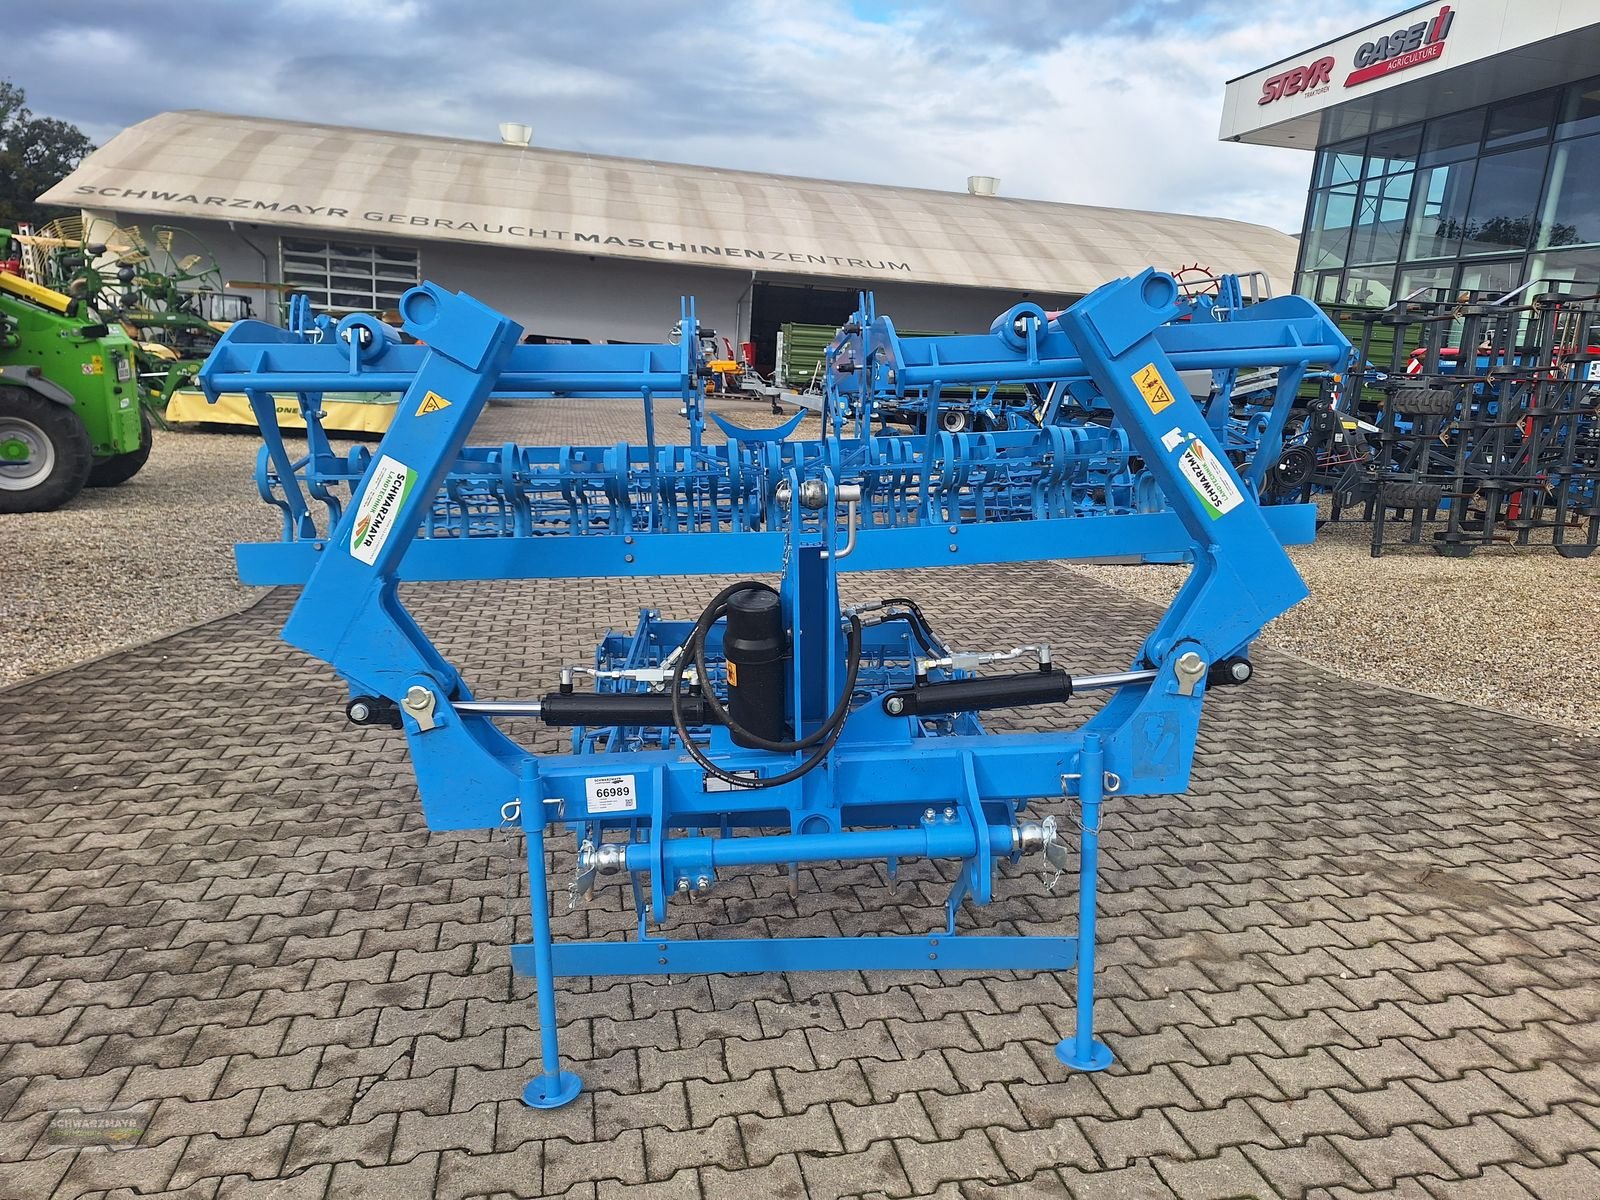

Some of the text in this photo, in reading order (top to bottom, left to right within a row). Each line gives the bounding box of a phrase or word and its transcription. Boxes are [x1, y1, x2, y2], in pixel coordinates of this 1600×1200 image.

[1353, 21, 1428, 68] CASE
[1387, 45, 1437, 70] AGRICULTURE
[1258, 56, 1335, 105] STEYR
[1304, 85, 1331, 98] TRAKTOREN
[74, 185, 912, 272] SCHWARZMAYR GEBRAUCHTMASCHINENZENTRUM
[370, 470, 395, 513] LANDTECHNIK
[1184, 451, 1222, 508] SCHWARZMA
[1202, 462, 1229, 501] LANDTECHNIK
[363, 473, 405, 547] SCHWARZMAYR
[596, 786, 630, 798] 66989
